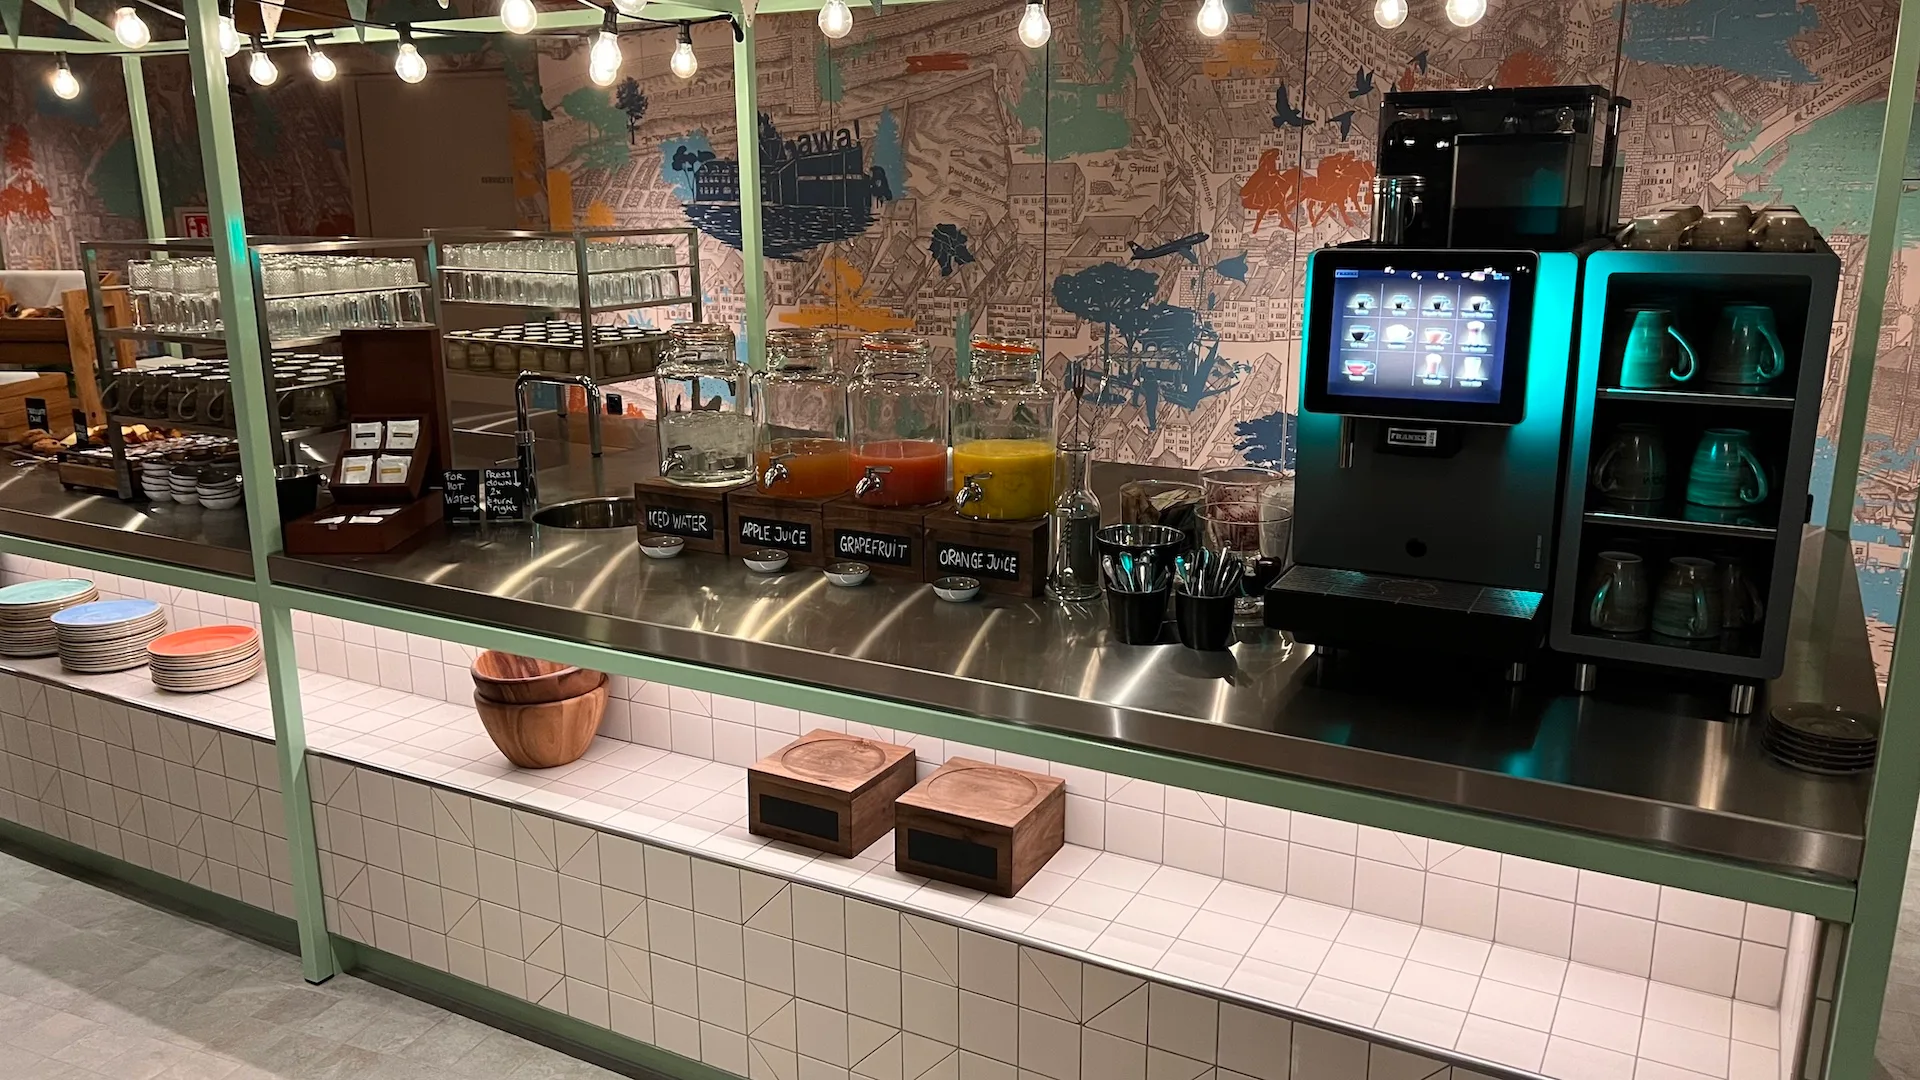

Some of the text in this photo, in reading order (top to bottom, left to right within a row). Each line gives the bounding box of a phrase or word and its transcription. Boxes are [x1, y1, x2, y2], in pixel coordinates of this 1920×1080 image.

[648, 510, 708, 532] ICED WATER
[741, 521, 772, 542] APPLE
[939, 548, 984, 570] ORANGE
